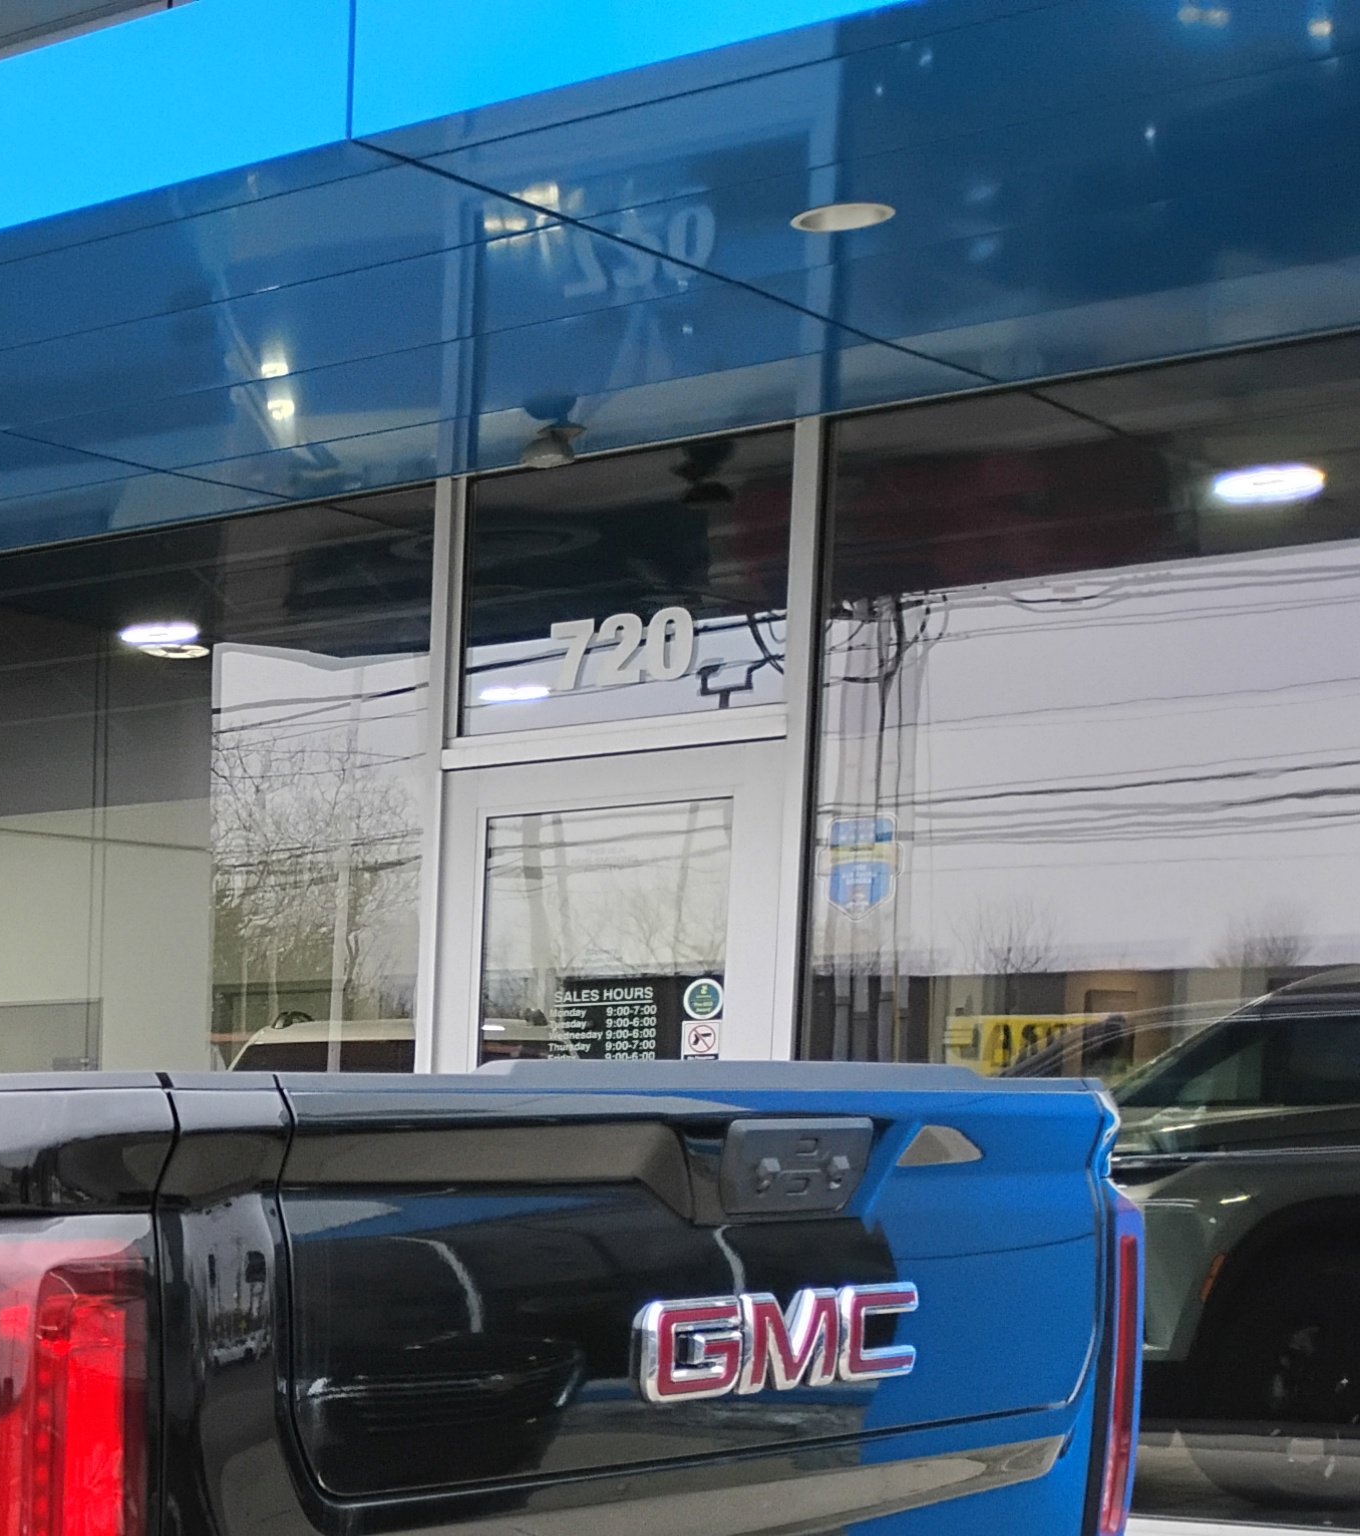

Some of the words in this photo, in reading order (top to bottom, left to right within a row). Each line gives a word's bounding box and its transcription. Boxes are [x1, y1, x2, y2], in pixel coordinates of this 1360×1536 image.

[550, 606, 694, 691] 720
[554, 989, 600, 1003] SALES
[603, 986, 654, 1001] HOURS
[606, 1005, 657, 1017] 9:00-7:00
[604, 1040, 656, 1051] 9:00-7:00
[633, 1281, 919, 1402] GMC
